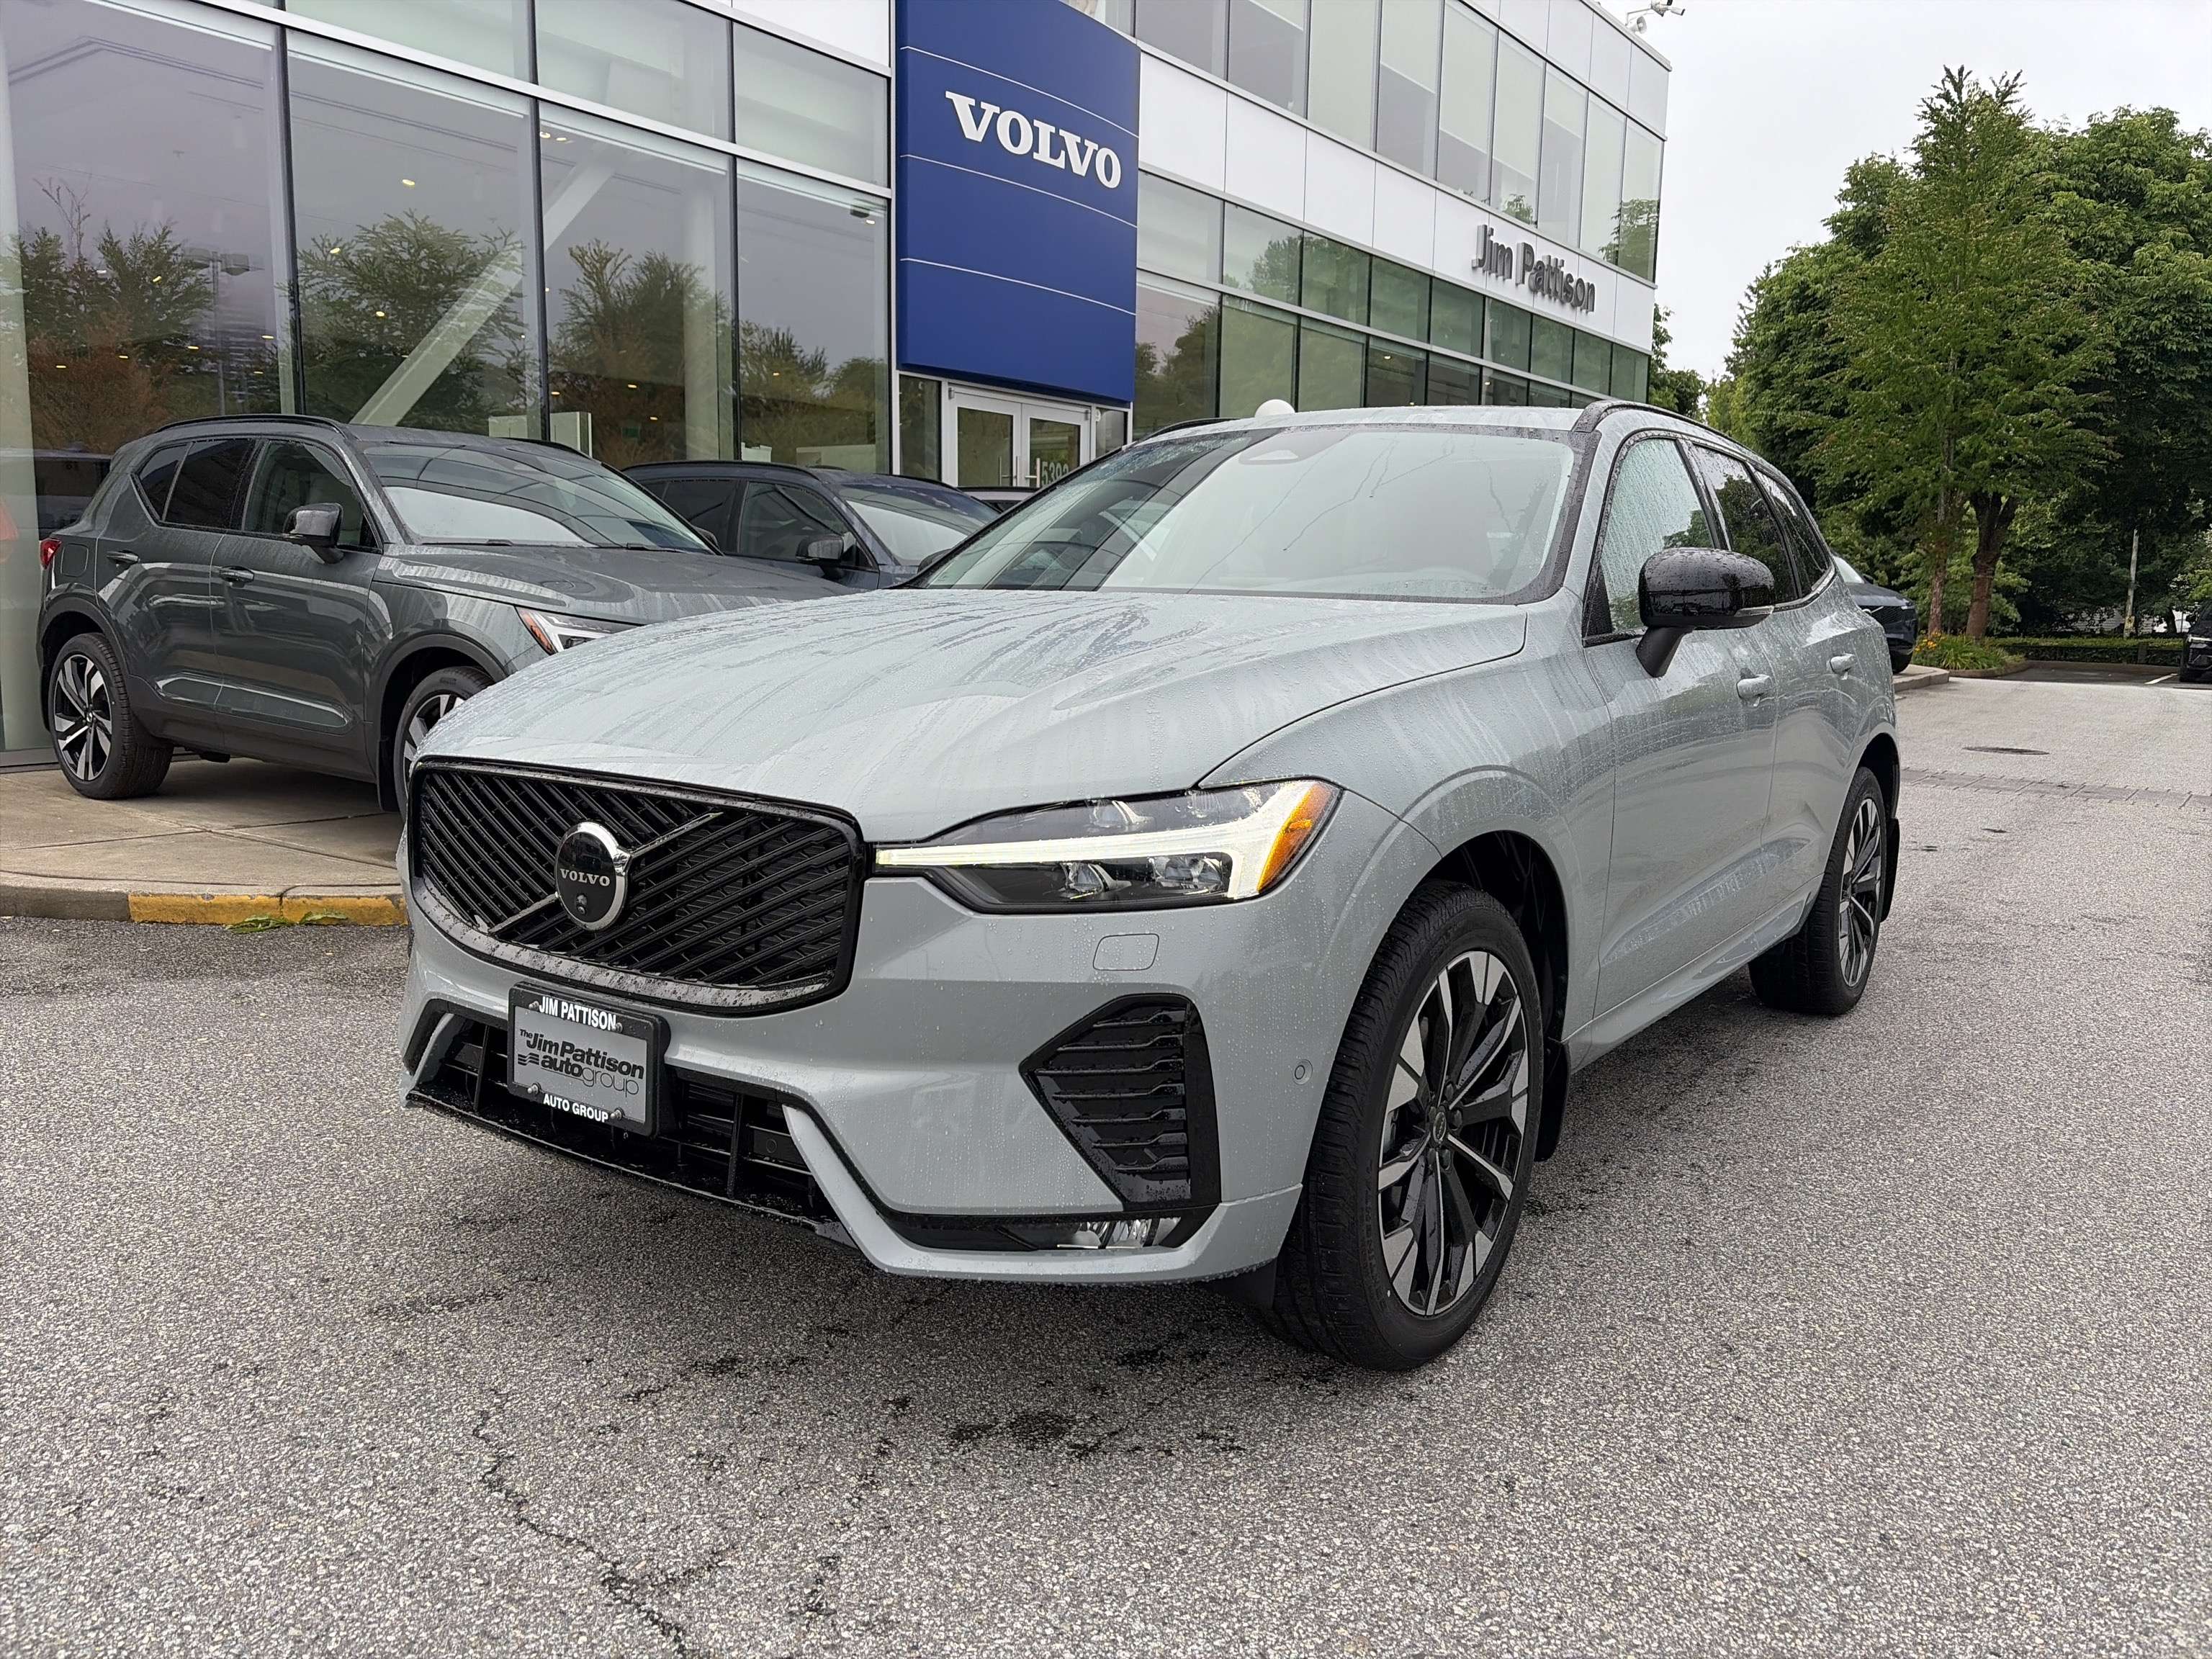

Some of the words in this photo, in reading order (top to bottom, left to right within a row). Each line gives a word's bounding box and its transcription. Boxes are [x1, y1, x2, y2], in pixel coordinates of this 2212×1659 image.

[945, 91, 1121, 189] VOLVO
[1471, 224, 1513, 280] Jim
[1515, 242, 1596, 313] Pattison
[559, 868, 611, 886] VOLVO
[540, 996, 558, 1017] JIM
[561, 1002, 616, 1031] PATTISON
[519, 1028, 533, 1039] The
[543, 1094, 570, 1111] AUTO
[572, 1102, 609, 1123] GROUP
